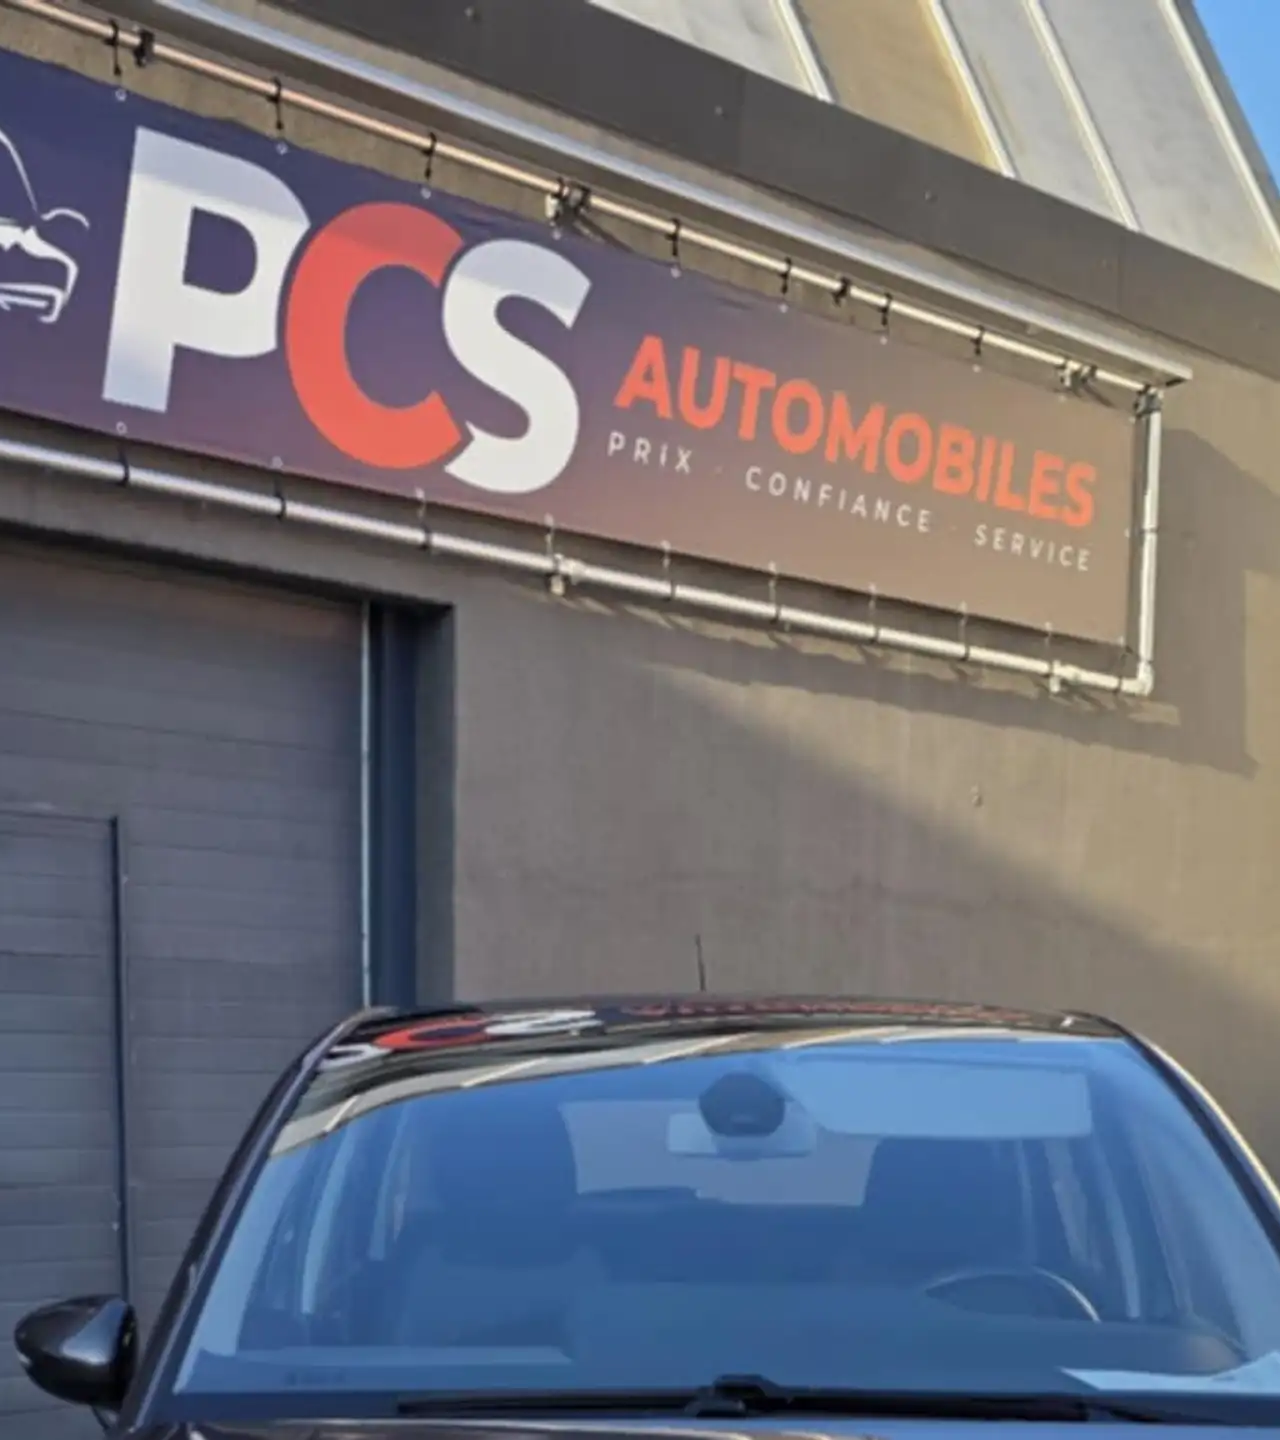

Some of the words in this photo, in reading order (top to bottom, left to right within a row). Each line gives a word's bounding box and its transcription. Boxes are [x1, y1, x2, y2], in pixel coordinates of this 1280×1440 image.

[102, 126, 592, 494] PCS
[607, 430, 692, 474] PRIX
[744, 464, 932, 533] CONFIANCE
[973, 523, 1091, 572] SERVICE
[614, 334, 1098, 527] AUTOMOBILES
